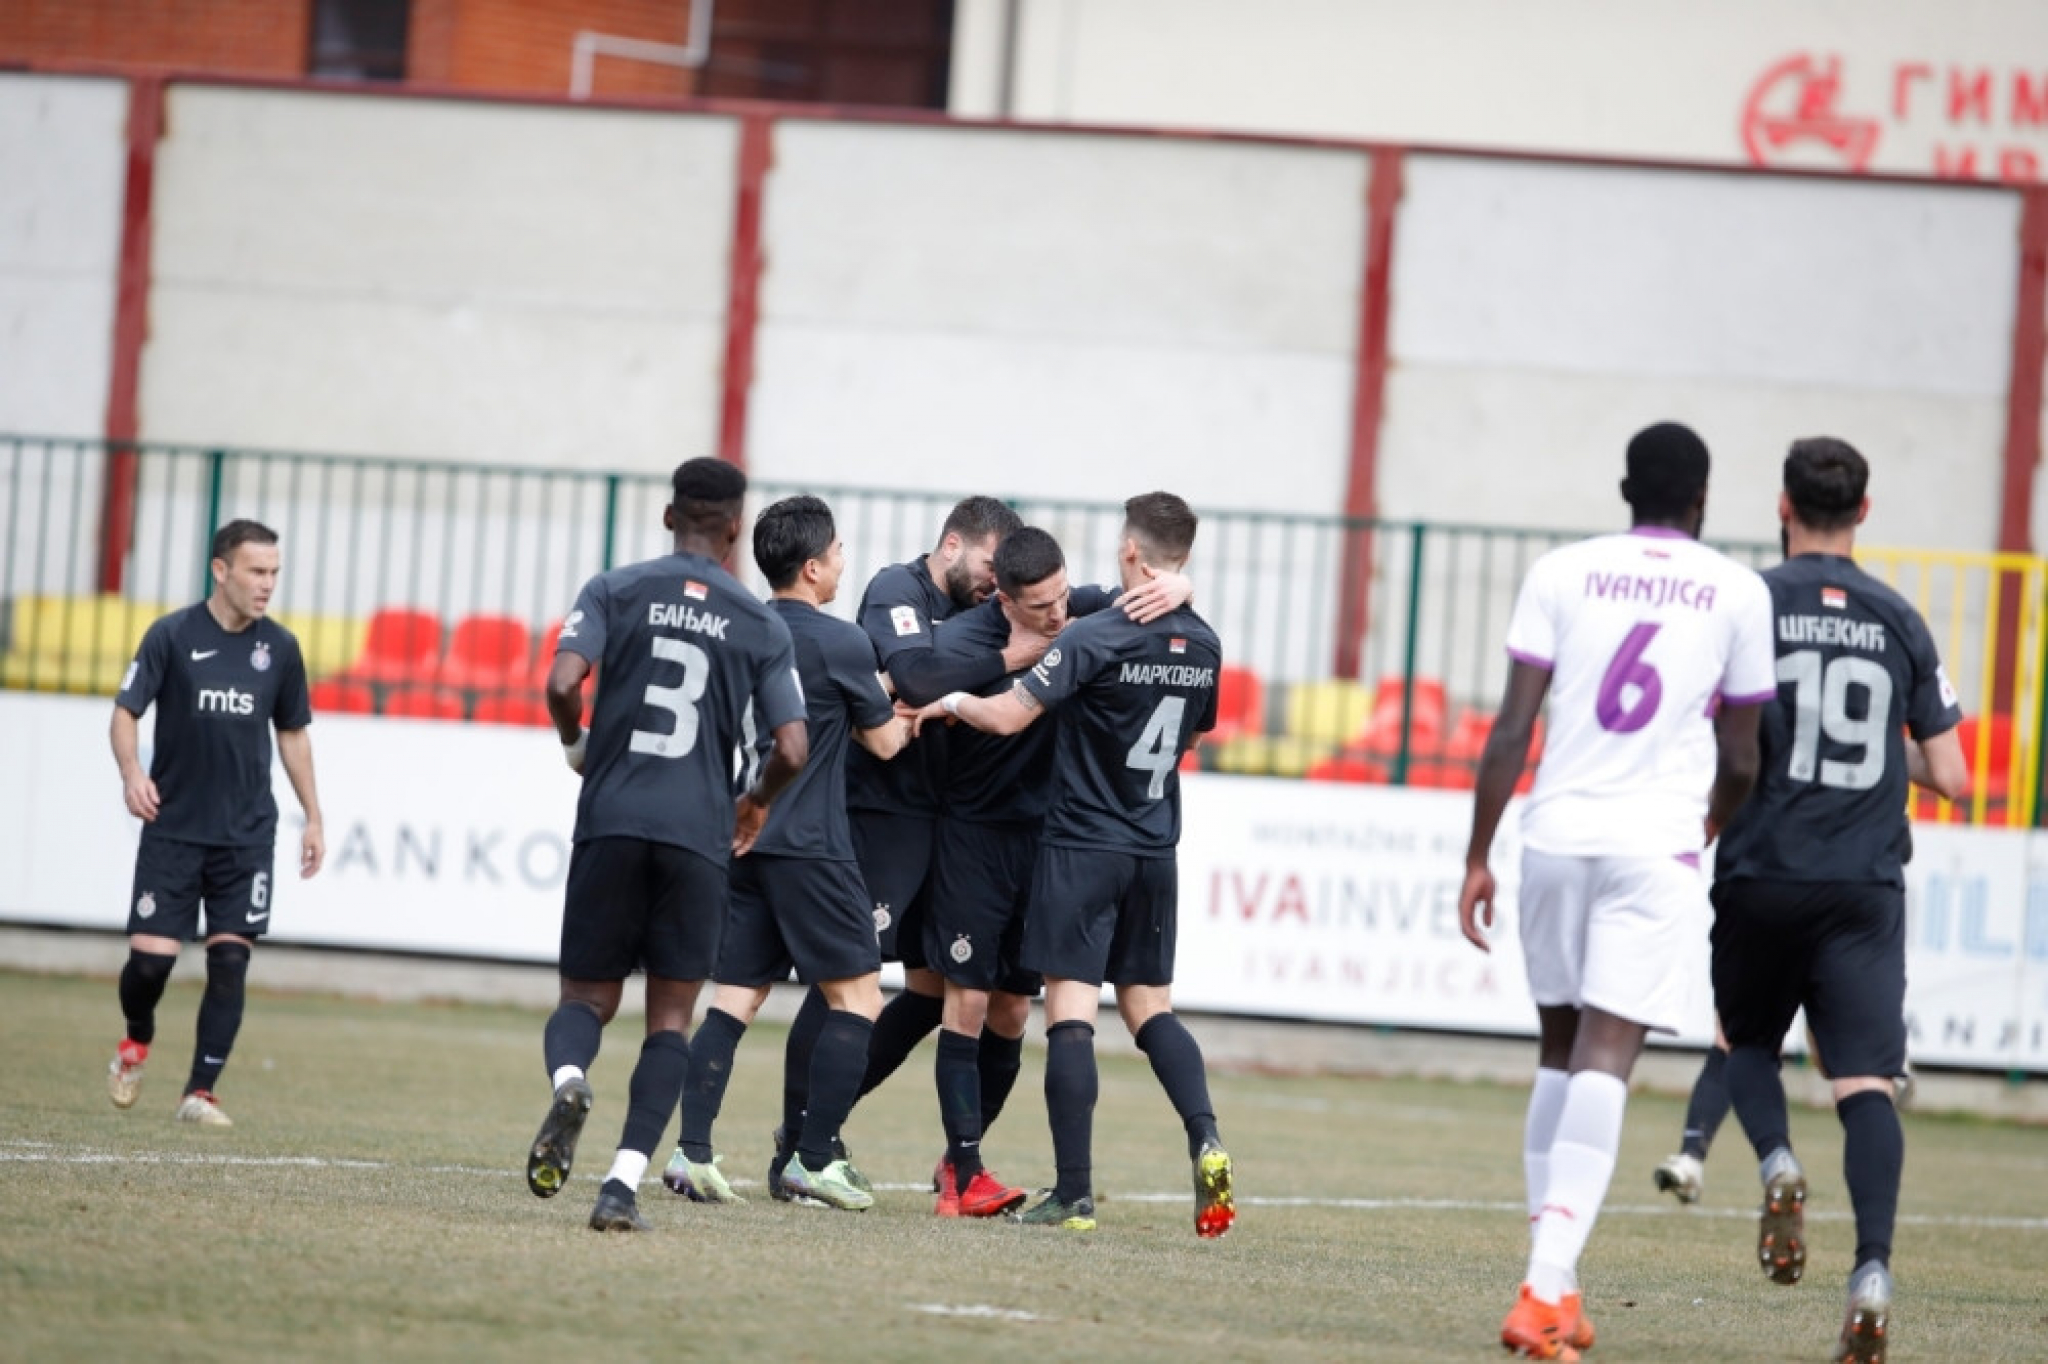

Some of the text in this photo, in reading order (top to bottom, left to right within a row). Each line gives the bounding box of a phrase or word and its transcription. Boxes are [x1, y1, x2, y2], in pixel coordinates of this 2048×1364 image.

[649, 603, 730, 641] БАЊАК
[1584, 571, 1717, 611] IVANJICA
[198, 687, 255, 715] mts
[628, 636, 710, 759] 3
[1596, 621, 1663, 735] 6
[1126, 695, 1187, 800] 4
[1776, 650, 1893, 790] 19
[251, 872, 268, 908] 6
[288, 818, 569, 892] ANKO
[1207, 869, 1505, 941] IVAINVE
